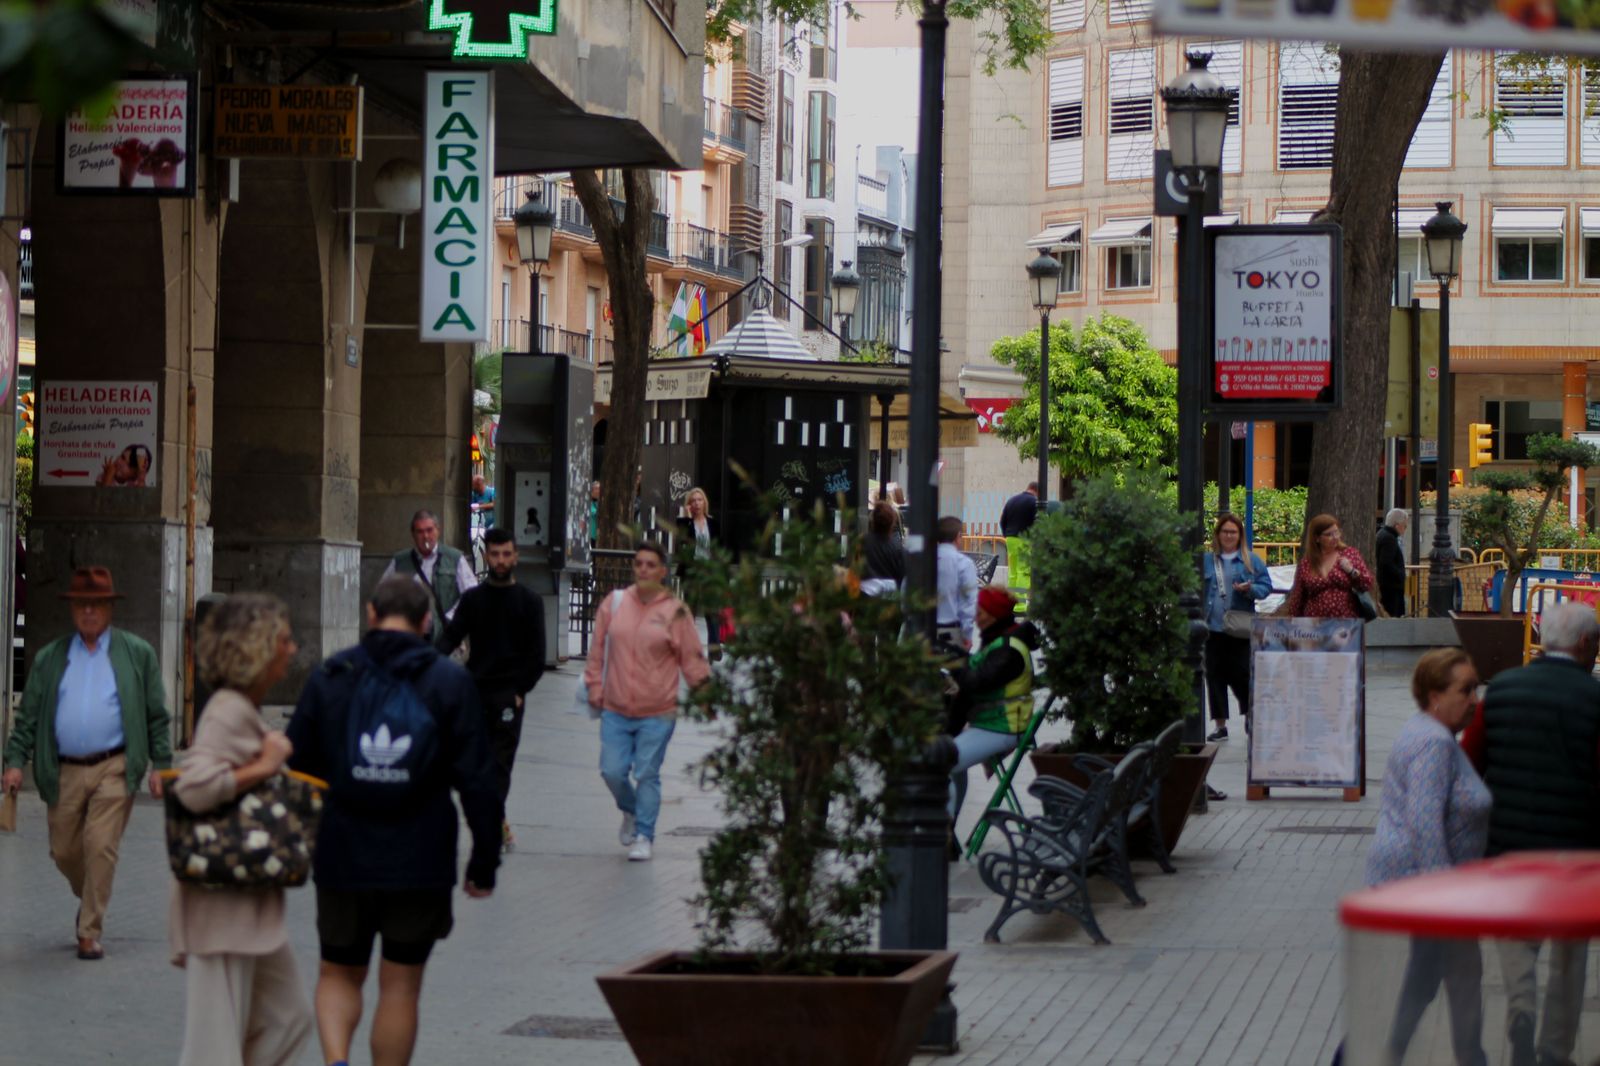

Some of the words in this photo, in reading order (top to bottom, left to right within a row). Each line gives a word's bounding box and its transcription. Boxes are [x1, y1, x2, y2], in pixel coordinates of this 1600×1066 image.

[219, 87, 272, 109] PEDRO
[279, 88, 354, 110] MORALES
[67, 102, 183, 119] HADERÍA
[117, 121, 183, 134] Valencianos
[225, 112, 274, 133] NUEVA
[287, 113, 348, 135] IMAGEN
[433, 80, 479, 331] FARMACIA
[1290, 256, 1319, 267] sushi
[1232, 271, 1321, 289] TOKYO
[1242, 301, 1290, 314] BUFFET
[1295, 301, 1304, 313] A
[1242, 315, 1260, 328] LA
[1263, 315, 1303, 328] CARTA
[1233, 374, 1246, 382] 959
[44, 385, 153, 402] HELADERÍA
[46, 405, 87, 415] Helados
[89, 405, 152, 415] Valencianos
[49, 421, 106, 434] Elaboración
[110, 418, 144, 430] Propia
[81, 440, 92, 448] de
[351, 764, 410, 782] adidas
